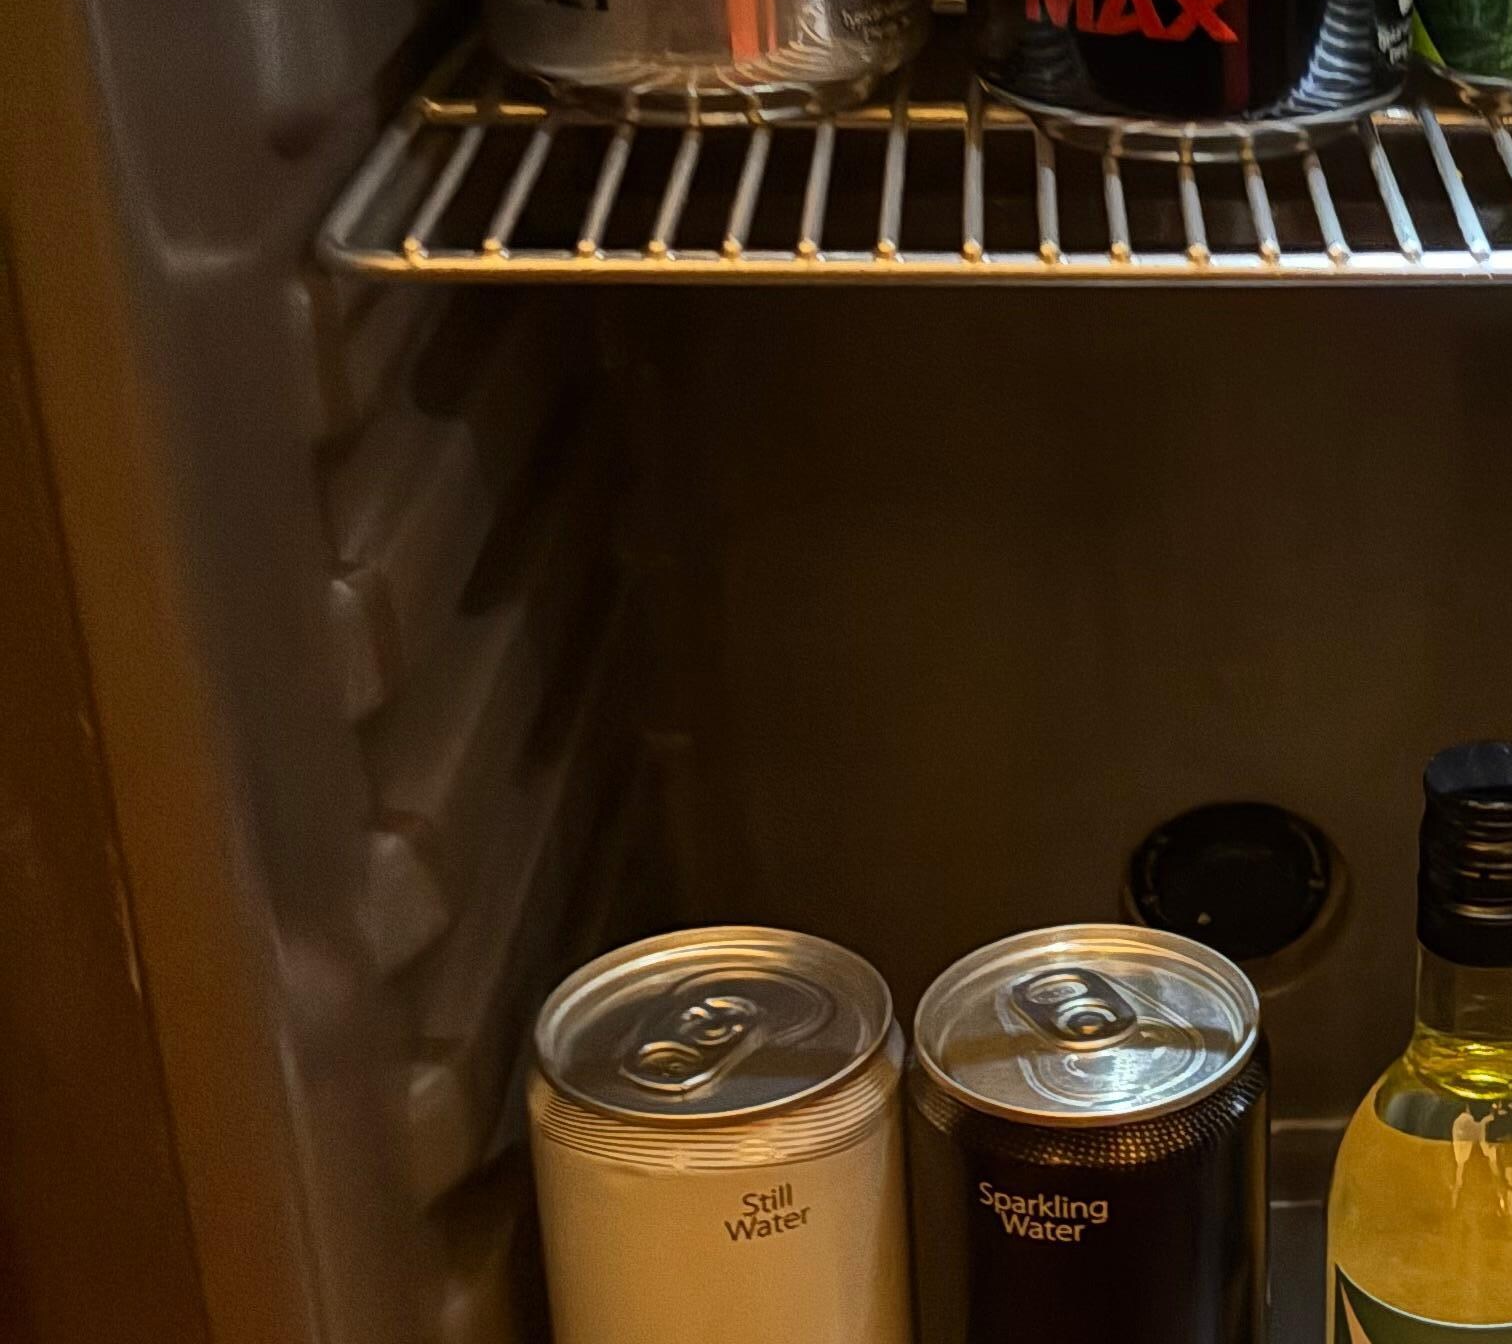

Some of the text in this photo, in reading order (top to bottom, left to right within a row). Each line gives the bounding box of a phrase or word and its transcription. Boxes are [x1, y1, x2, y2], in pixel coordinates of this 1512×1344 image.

[742, 1182, 793, 1218] Still
[978, 1181, 1109, 1224] Sparkling
[724, 1205, 811, 1242] Water
[1000, 1210, 1086, 1243] Water
